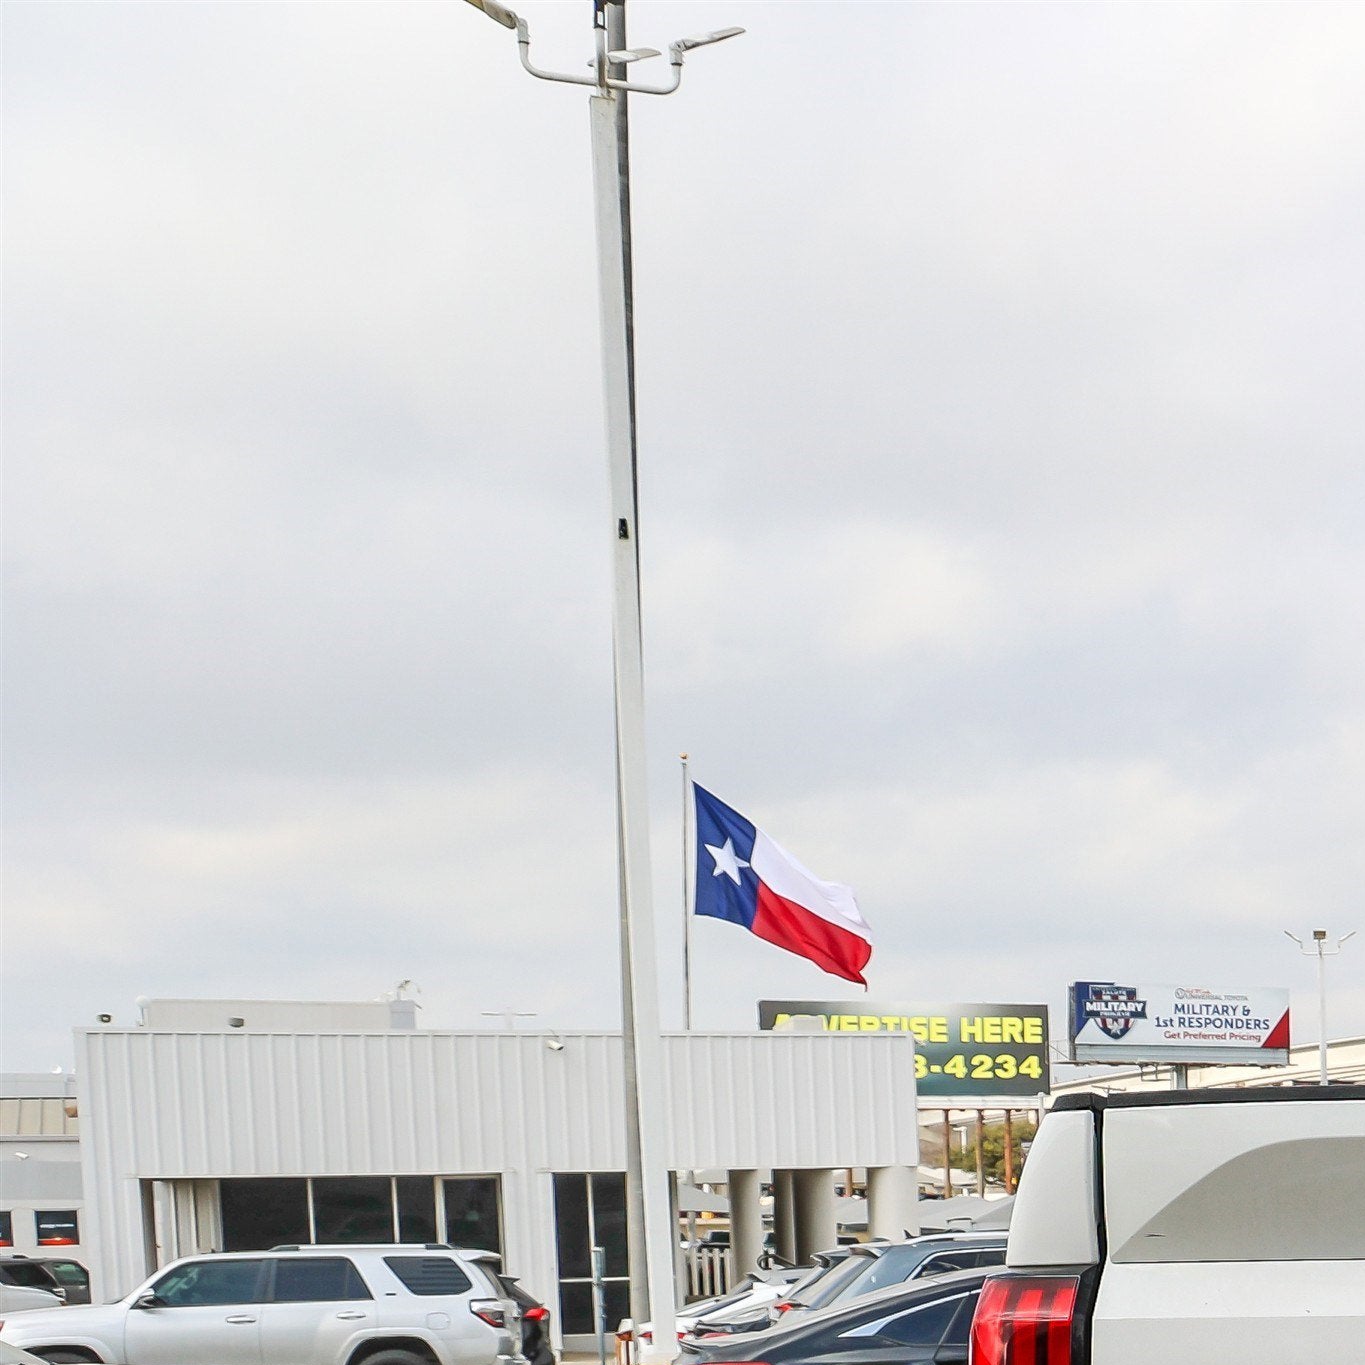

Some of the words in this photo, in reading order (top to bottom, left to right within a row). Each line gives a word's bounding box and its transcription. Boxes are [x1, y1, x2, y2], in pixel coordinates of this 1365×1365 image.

[1085, 1001, 1144, 1012] MILITARY
[1174, 1003, 1238, 1016] MILITARY
[1242, 1005, 1251, 1016] &
[1155, 1017, 1174, 1028] 1st
[1178, 1016, 1270, 1030] RESPONDERS
[960, 1016, 1043, 1044] HERE
[1164, 1030, 1180, 1039] Get
[1183, 1031, 1226, 1040] Preferred
[1229, 1032, 1261, 1042] Pricing
